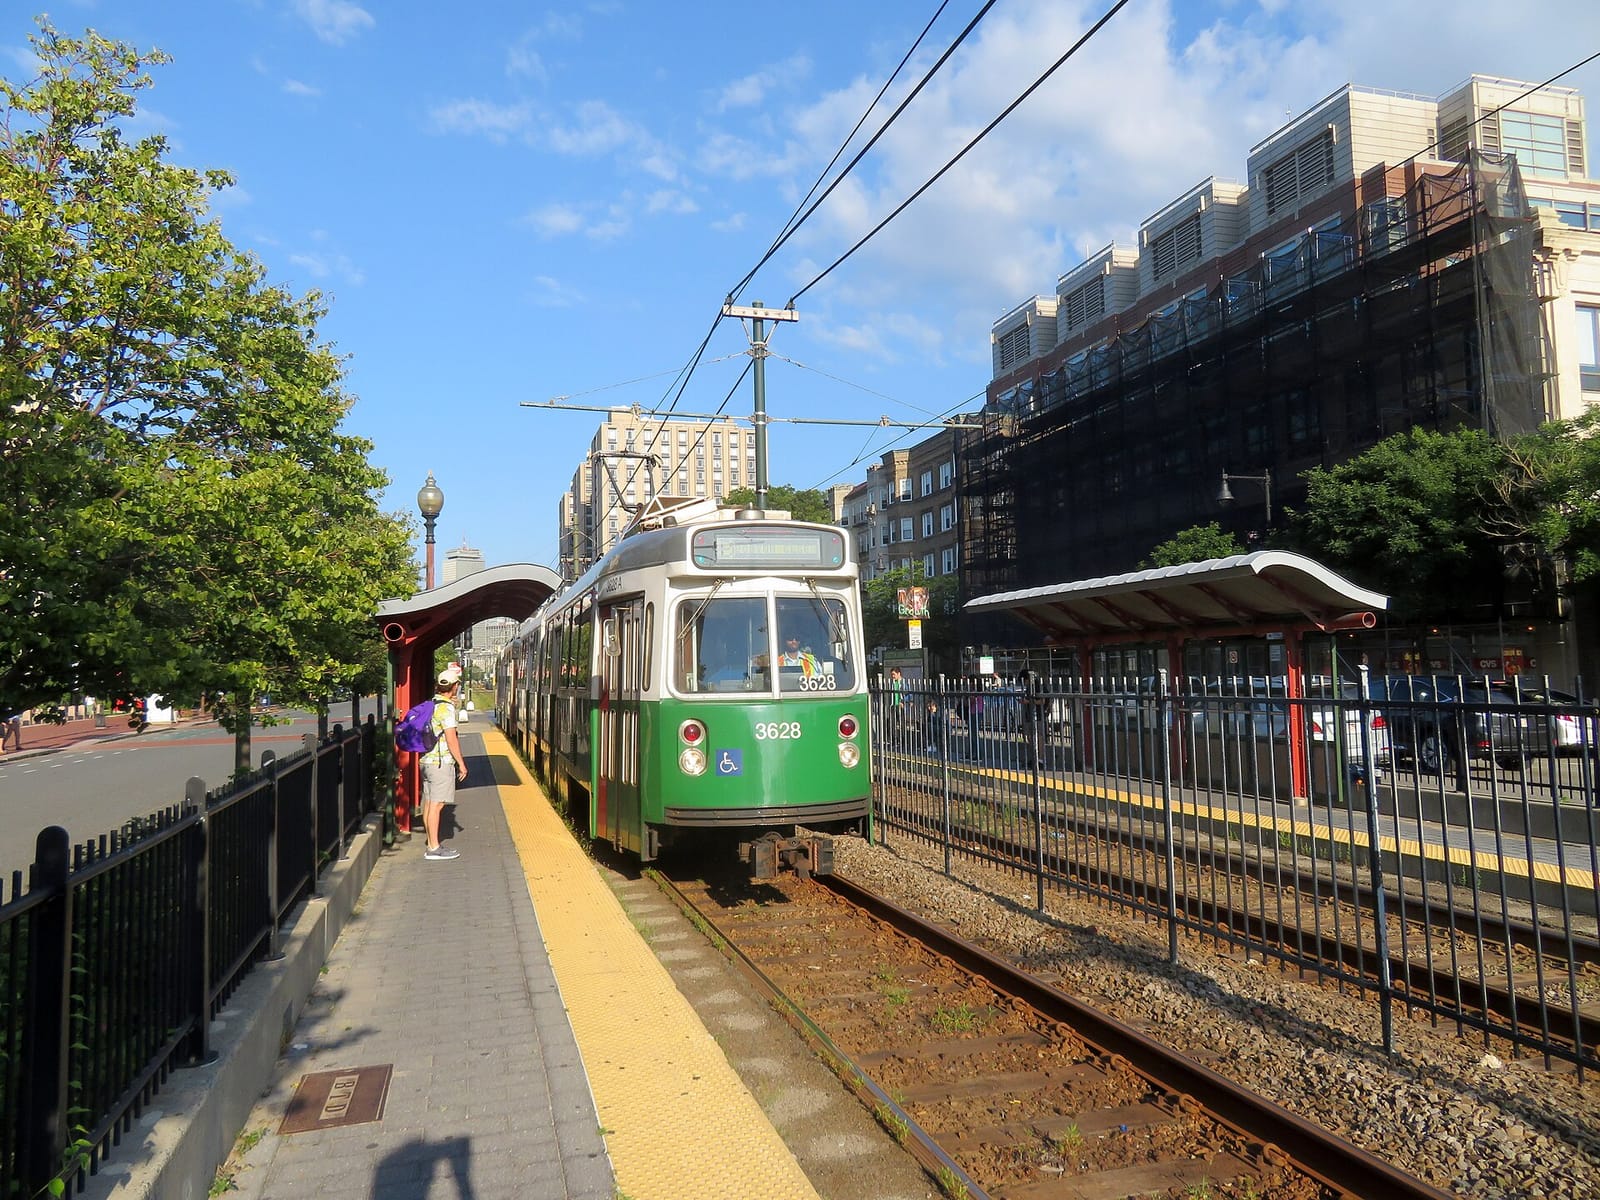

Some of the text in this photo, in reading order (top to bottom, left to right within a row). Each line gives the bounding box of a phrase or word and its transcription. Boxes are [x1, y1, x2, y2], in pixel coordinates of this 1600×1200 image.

[911, 639, 921, 647] 25
[1479, 659, 1497, 668] CVS
[799, 674, 836, 691] 3628
[755, 722, 801, 740] 3628
